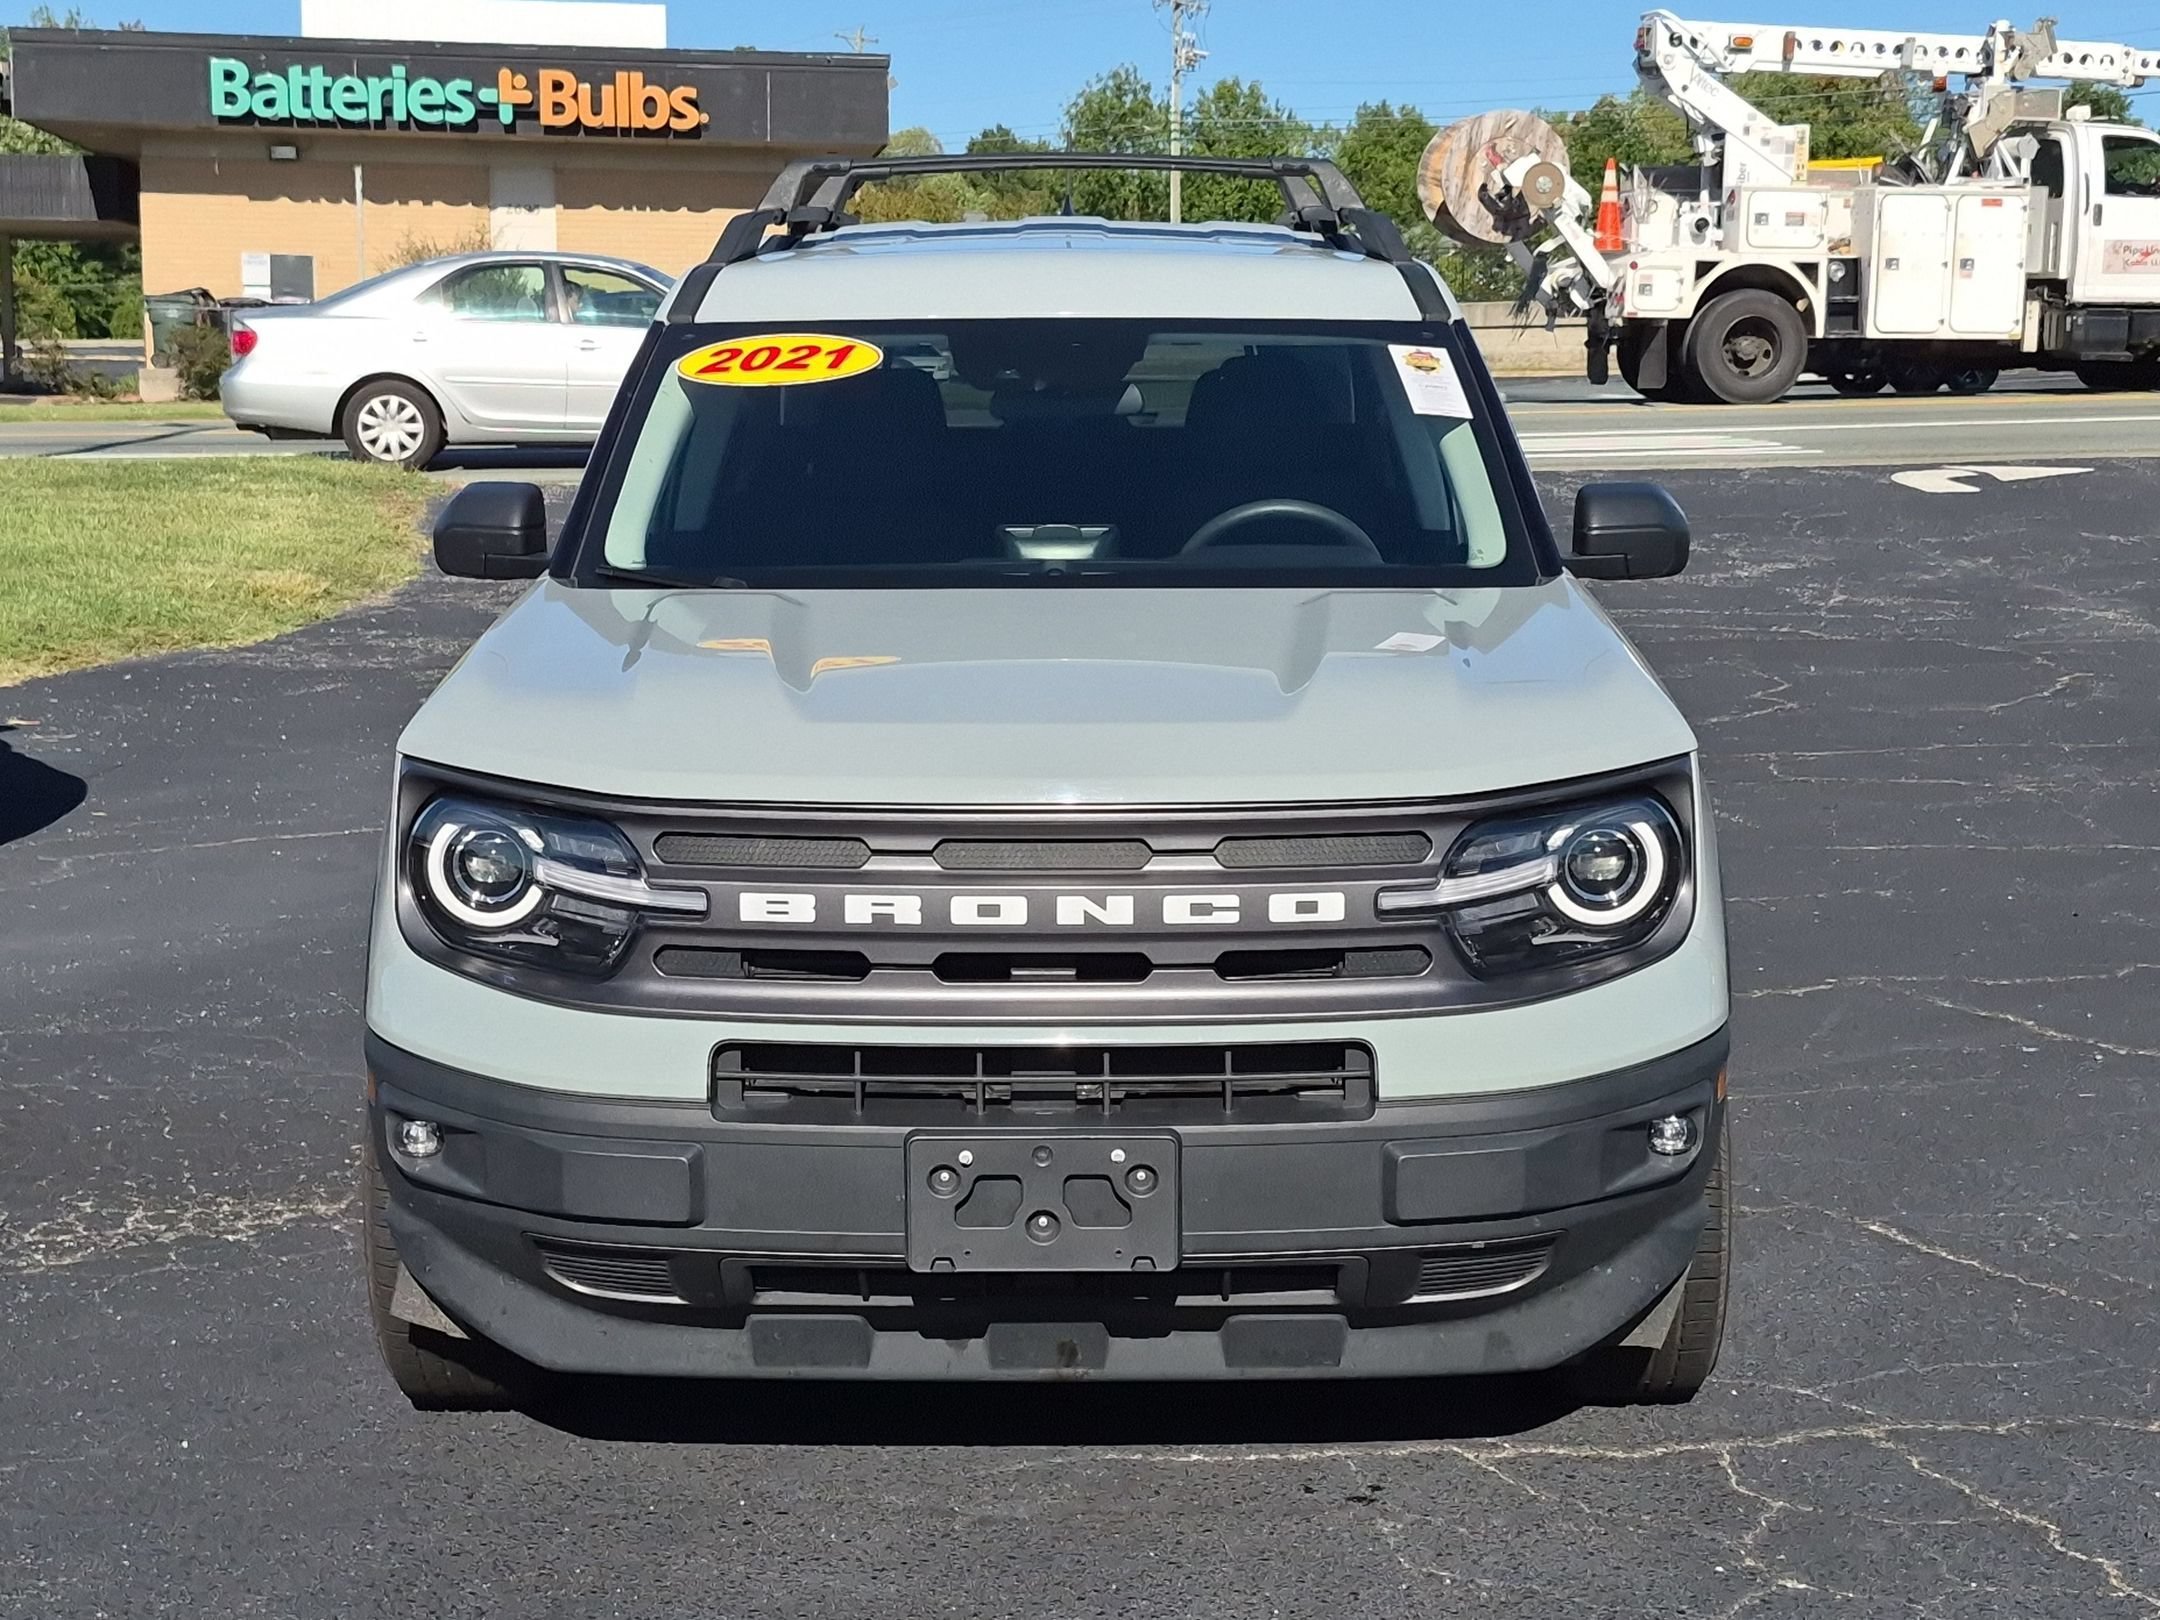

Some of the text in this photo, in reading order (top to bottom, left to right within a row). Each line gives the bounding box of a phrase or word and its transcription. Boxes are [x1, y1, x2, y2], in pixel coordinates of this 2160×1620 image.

[209, 56, 476, 125] Batteries
[694, 344, 857, 375] 2021
[738, 891, 1346, 926] BRONCO
